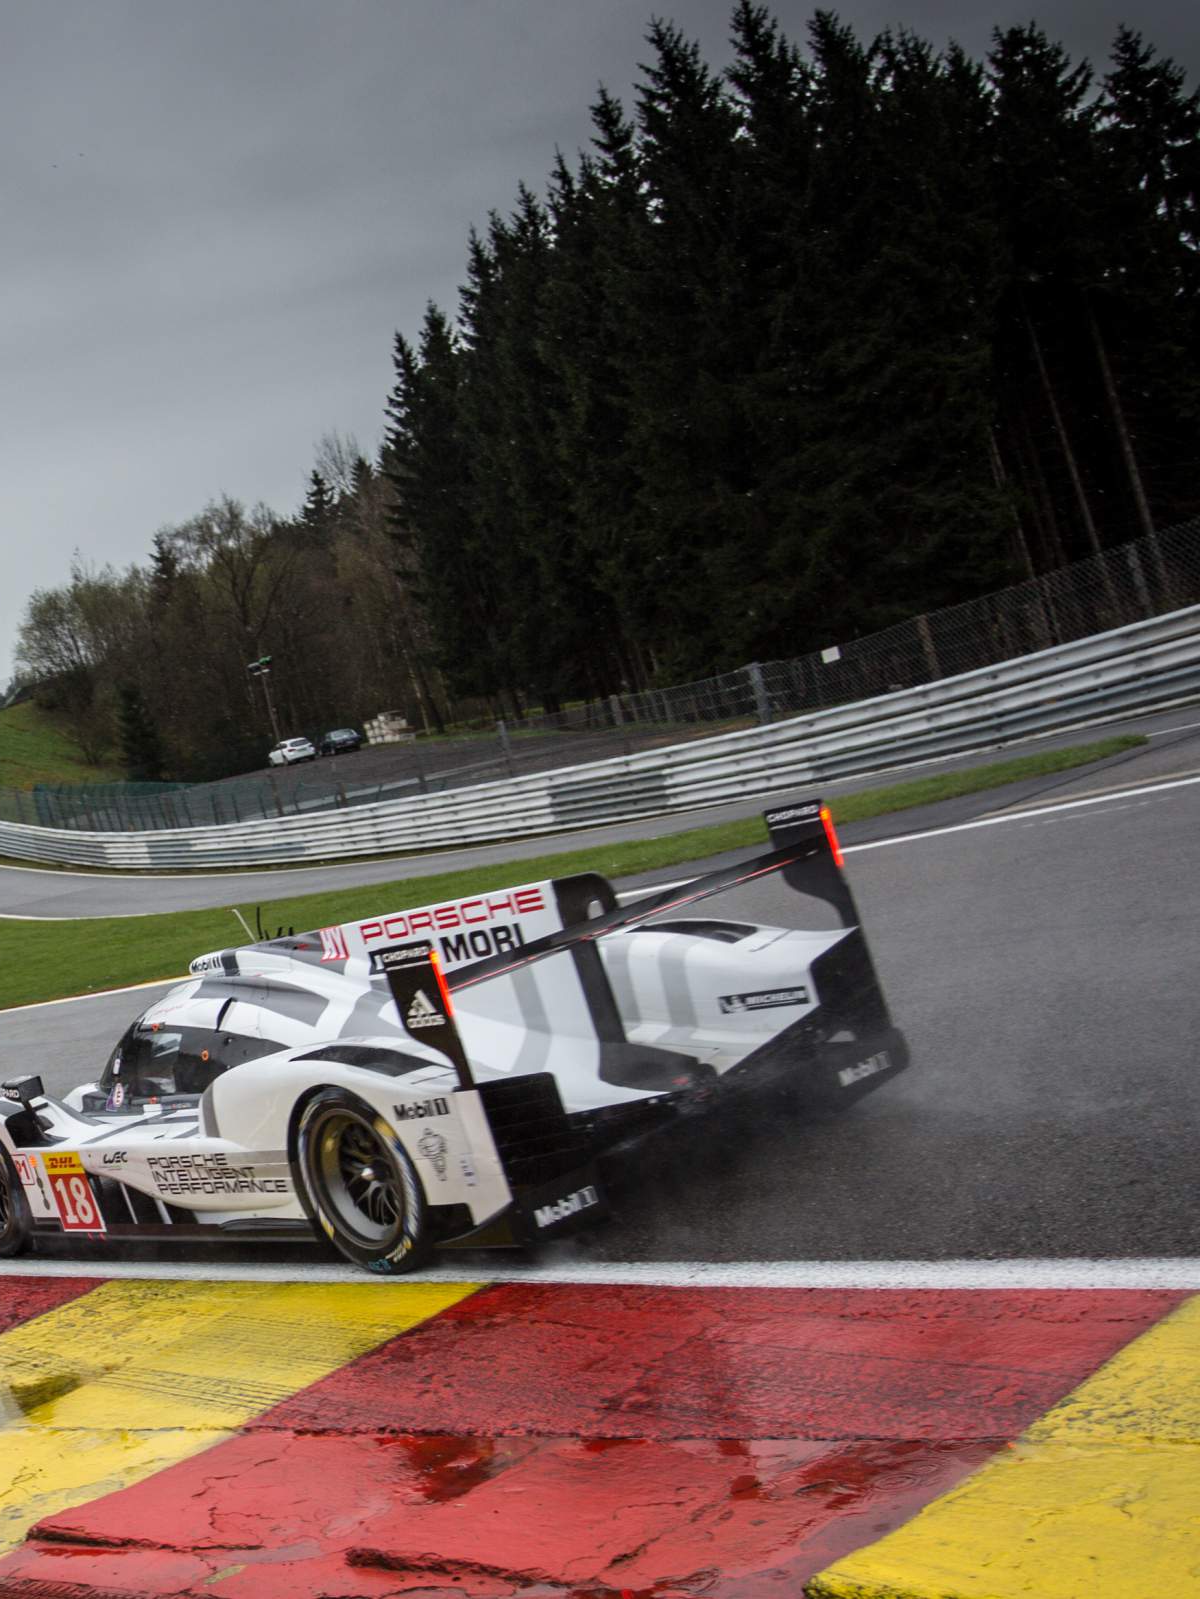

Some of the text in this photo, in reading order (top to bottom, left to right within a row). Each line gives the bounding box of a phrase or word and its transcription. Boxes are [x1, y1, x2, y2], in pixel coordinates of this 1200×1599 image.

[359, 888, 547, 944] PORSCHE
[439, 922, 526, 963] MORI
[191, 957, 213, 973] Mobil
[746, 989, 808, 1006] MICHELIN
[837, 1055, 879, 1088] Mobil
[392, 1099, 434, 1122] Mobil
[48, 1157, 77, 1169] DHL
[103, 1151, 129, 1164] WEC
[147, 1152, 229, 1169] PORSCHE
[151, 1166, 257, 1183] INTELLIGENT
[157, 1179, 289, 1195] PERFORMANCE
[54, 1176, 95, 1225] 18
[533, 1192, 581, 1228] Mobil
